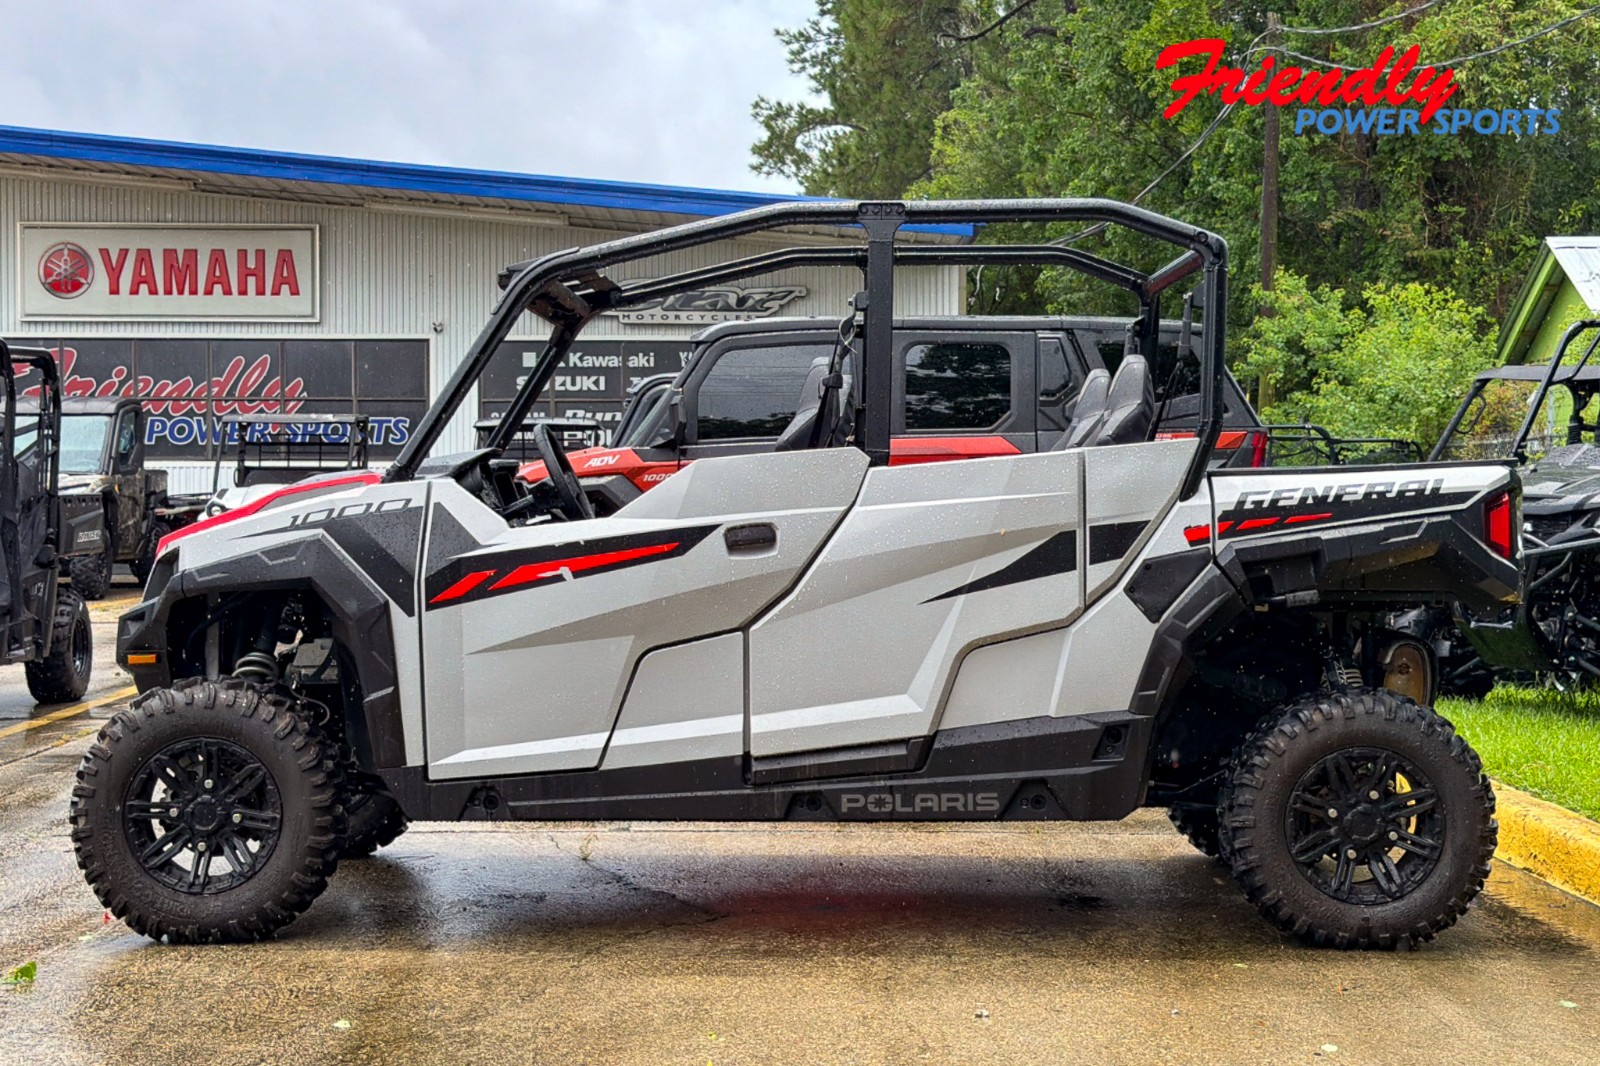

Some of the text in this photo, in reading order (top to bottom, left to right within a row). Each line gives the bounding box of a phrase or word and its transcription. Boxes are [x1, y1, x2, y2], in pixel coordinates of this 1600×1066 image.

[99, 248, 300, 296] YAMAHA
[622, 313, 755, 322] MOTORCYCLES
[516, 375, 606, 391] SZUKI
[144, 416, 273, 446] POWER
[584, 454, 621, 469] ADV
[1233, 478, 1445, 510] GENERAL
[287, 498, 412, 530] 1000
[841, 792, 1000, 813] POLARIS
